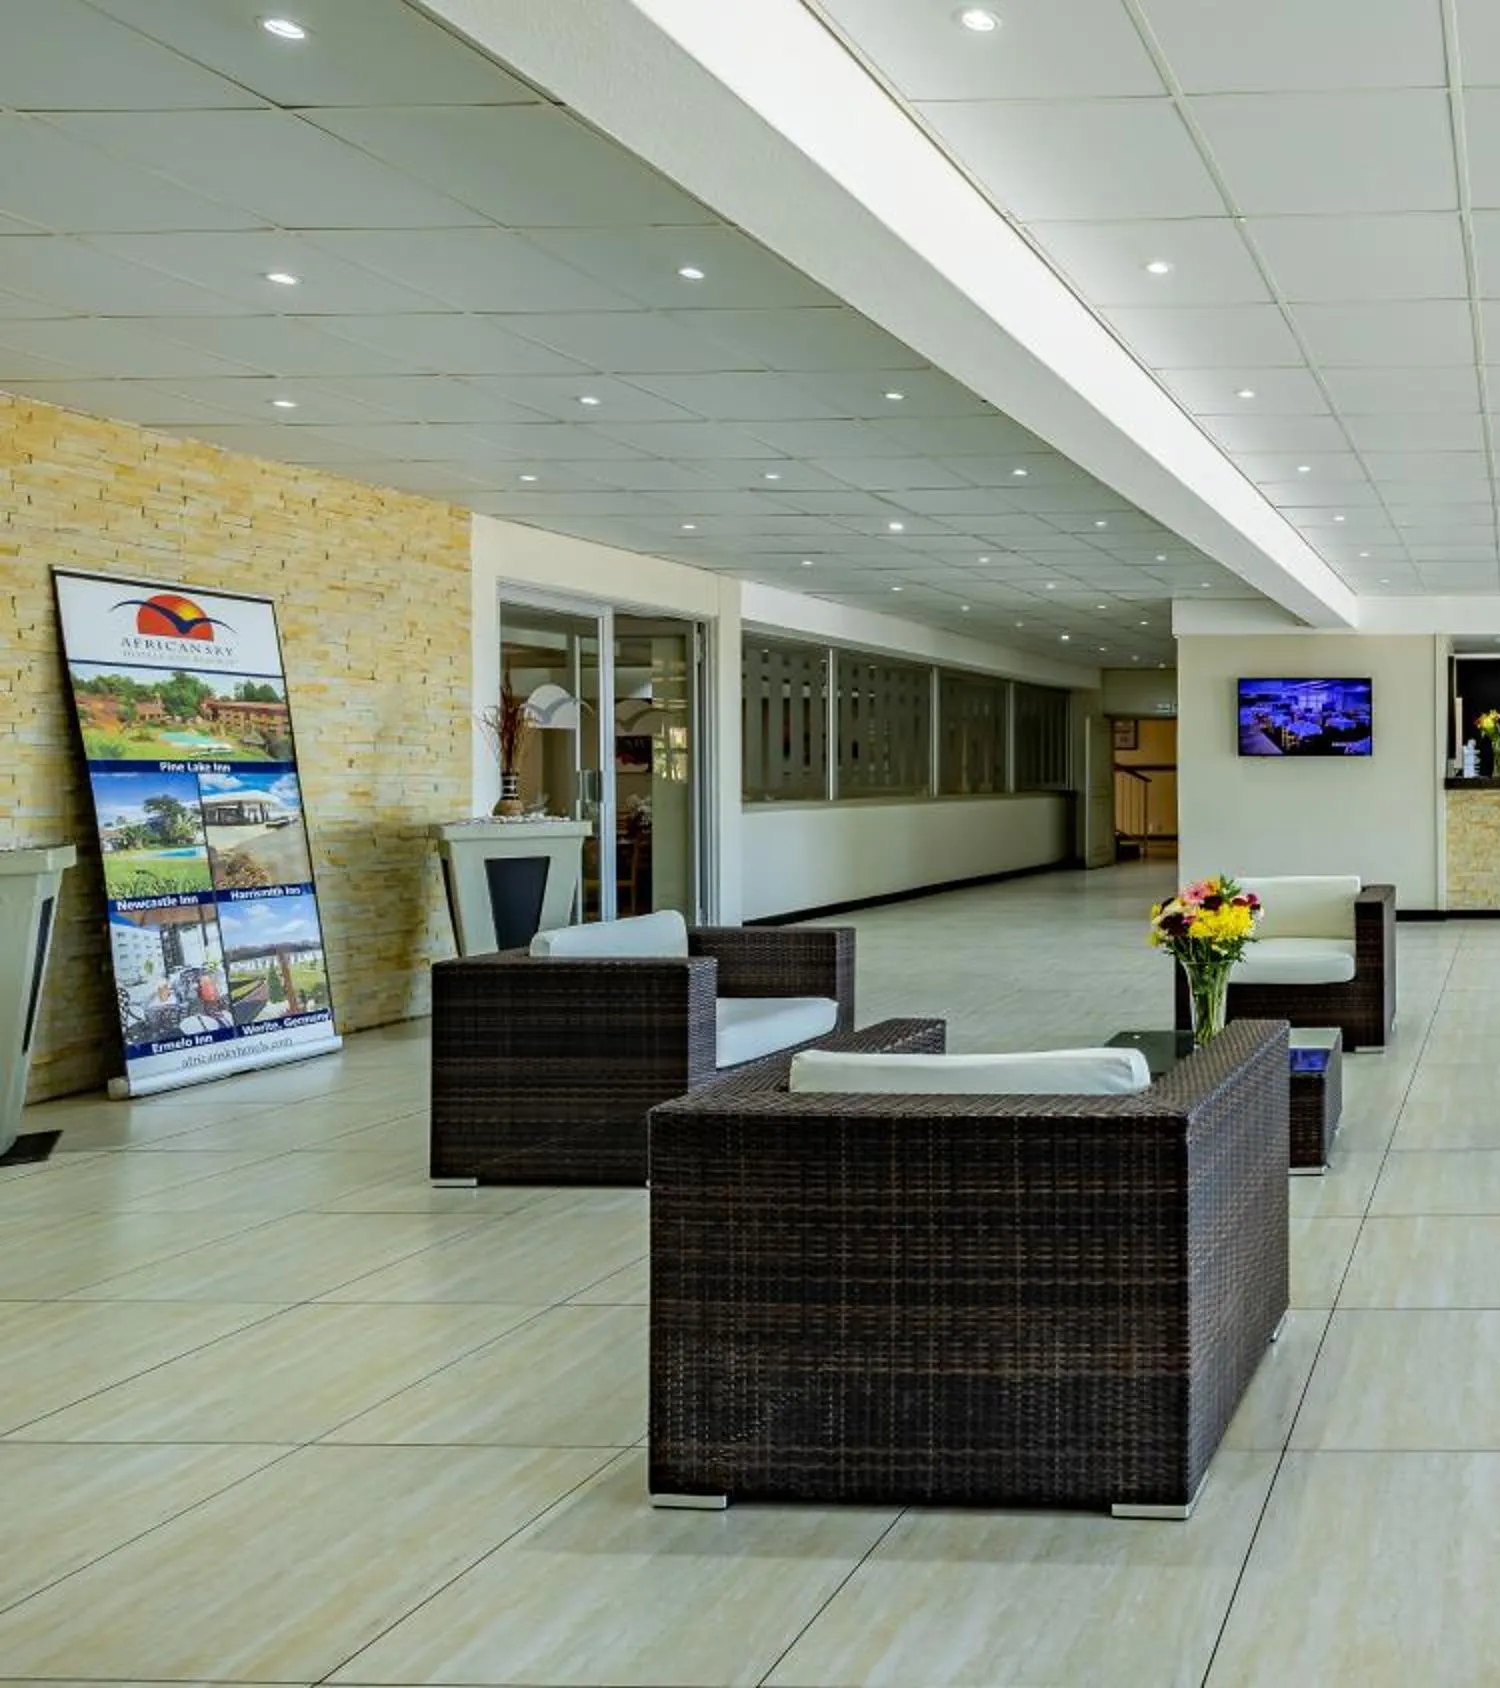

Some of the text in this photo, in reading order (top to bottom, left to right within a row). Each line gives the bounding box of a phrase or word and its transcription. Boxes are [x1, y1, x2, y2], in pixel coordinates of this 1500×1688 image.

[160, 761, 231, 773] Pine Lake Inn
[230, 886, 301, 900] Harrismith Inn
[116, 895, 199, 911] Newcastle Inn
[151, 1033, 213, 1054] Ermelo Inn
